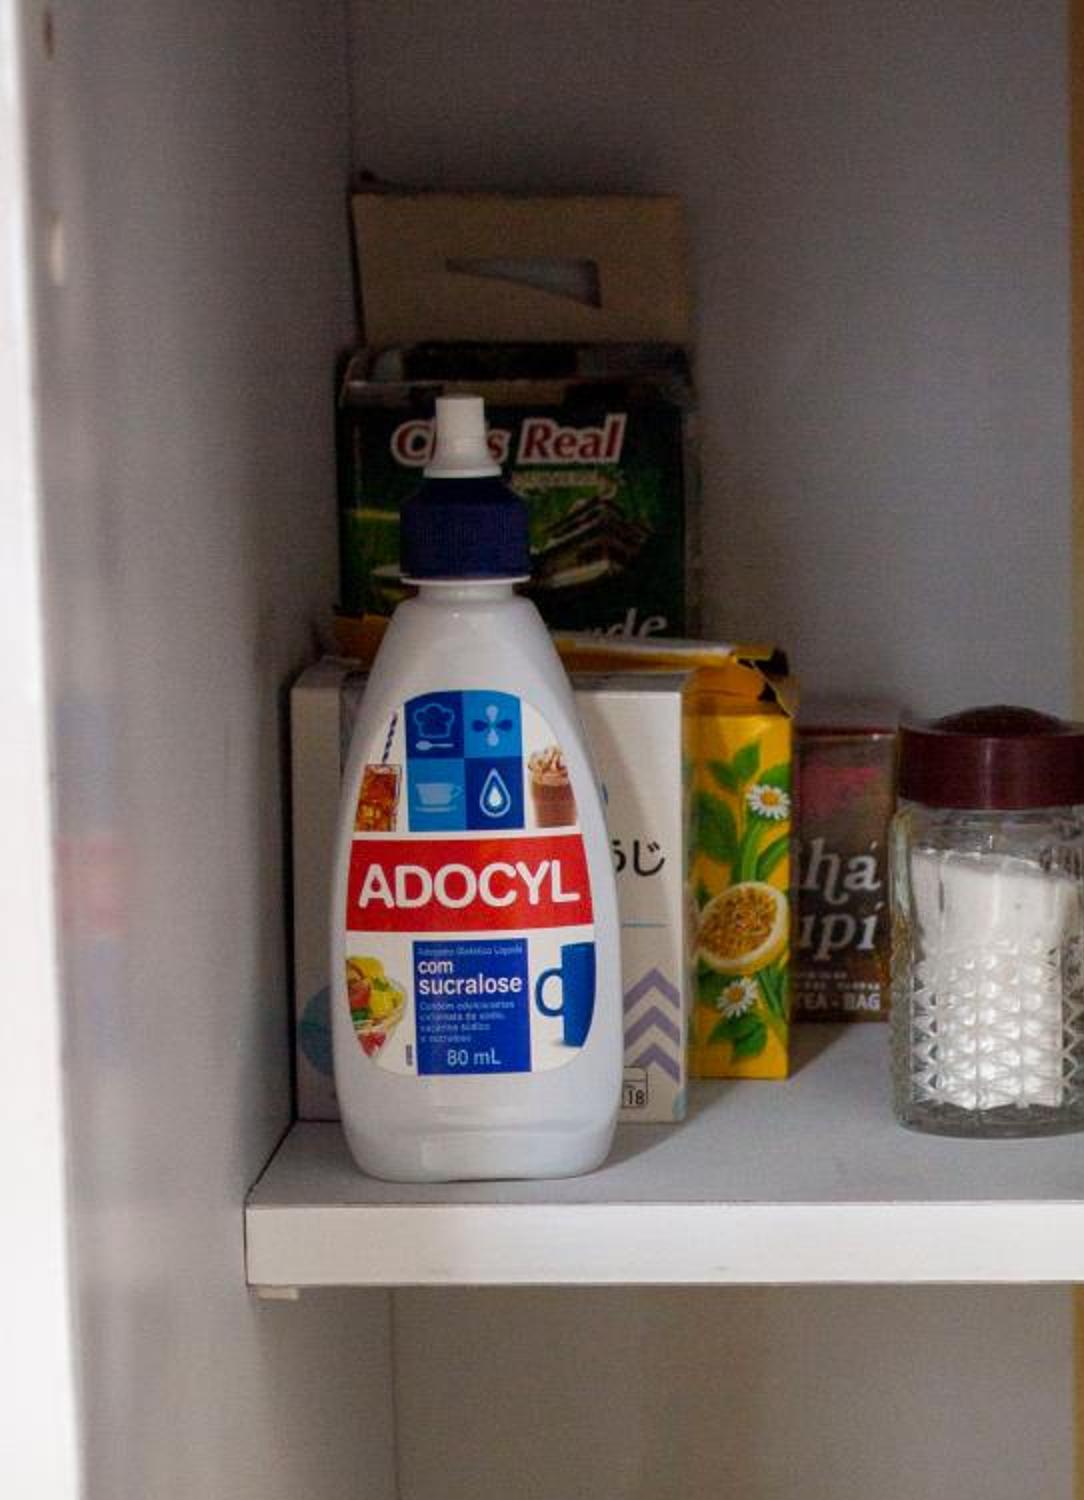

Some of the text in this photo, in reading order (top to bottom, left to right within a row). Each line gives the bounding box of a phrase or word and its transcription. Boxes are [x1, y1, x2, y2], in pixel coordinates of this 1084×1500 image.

[517, 413, 627, 465] Real
[357, 858, 581, 909] ADOCYL
[799, 837, 882, 906] há
[417, 960, 454, 975] com
[418, 972, 523, 996] sucralose
[447, 1047, 502, 1067] 80 mL
